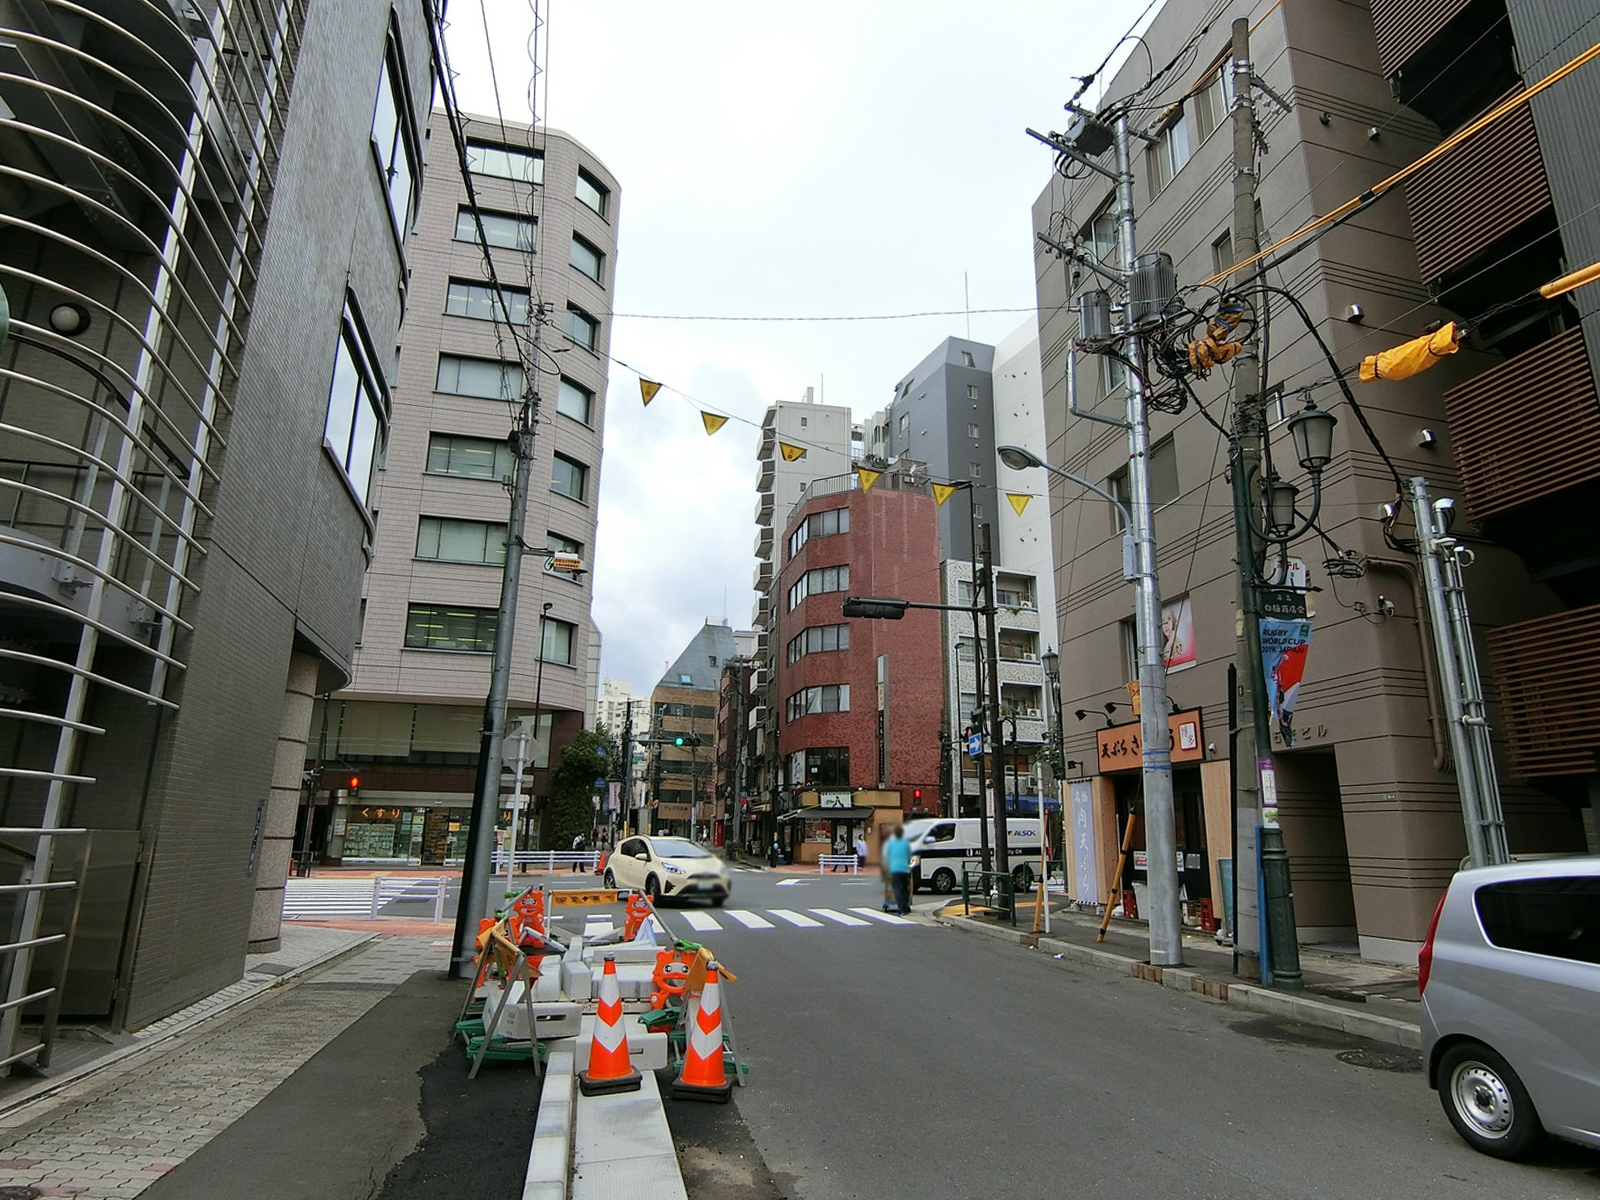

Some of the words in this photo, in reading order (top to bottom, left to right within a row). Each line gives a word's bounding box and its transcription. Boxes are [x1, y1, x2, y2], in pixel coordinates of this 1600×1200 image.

[1262, 628, 1288, 637] RUGBY
[1262, 637, 1287, 645] WORLD
[1288, 637, 1306, 646] CUP
[1278, 646, 1305, 654] JAPAN
[361, 807, 401, 819] くすり
